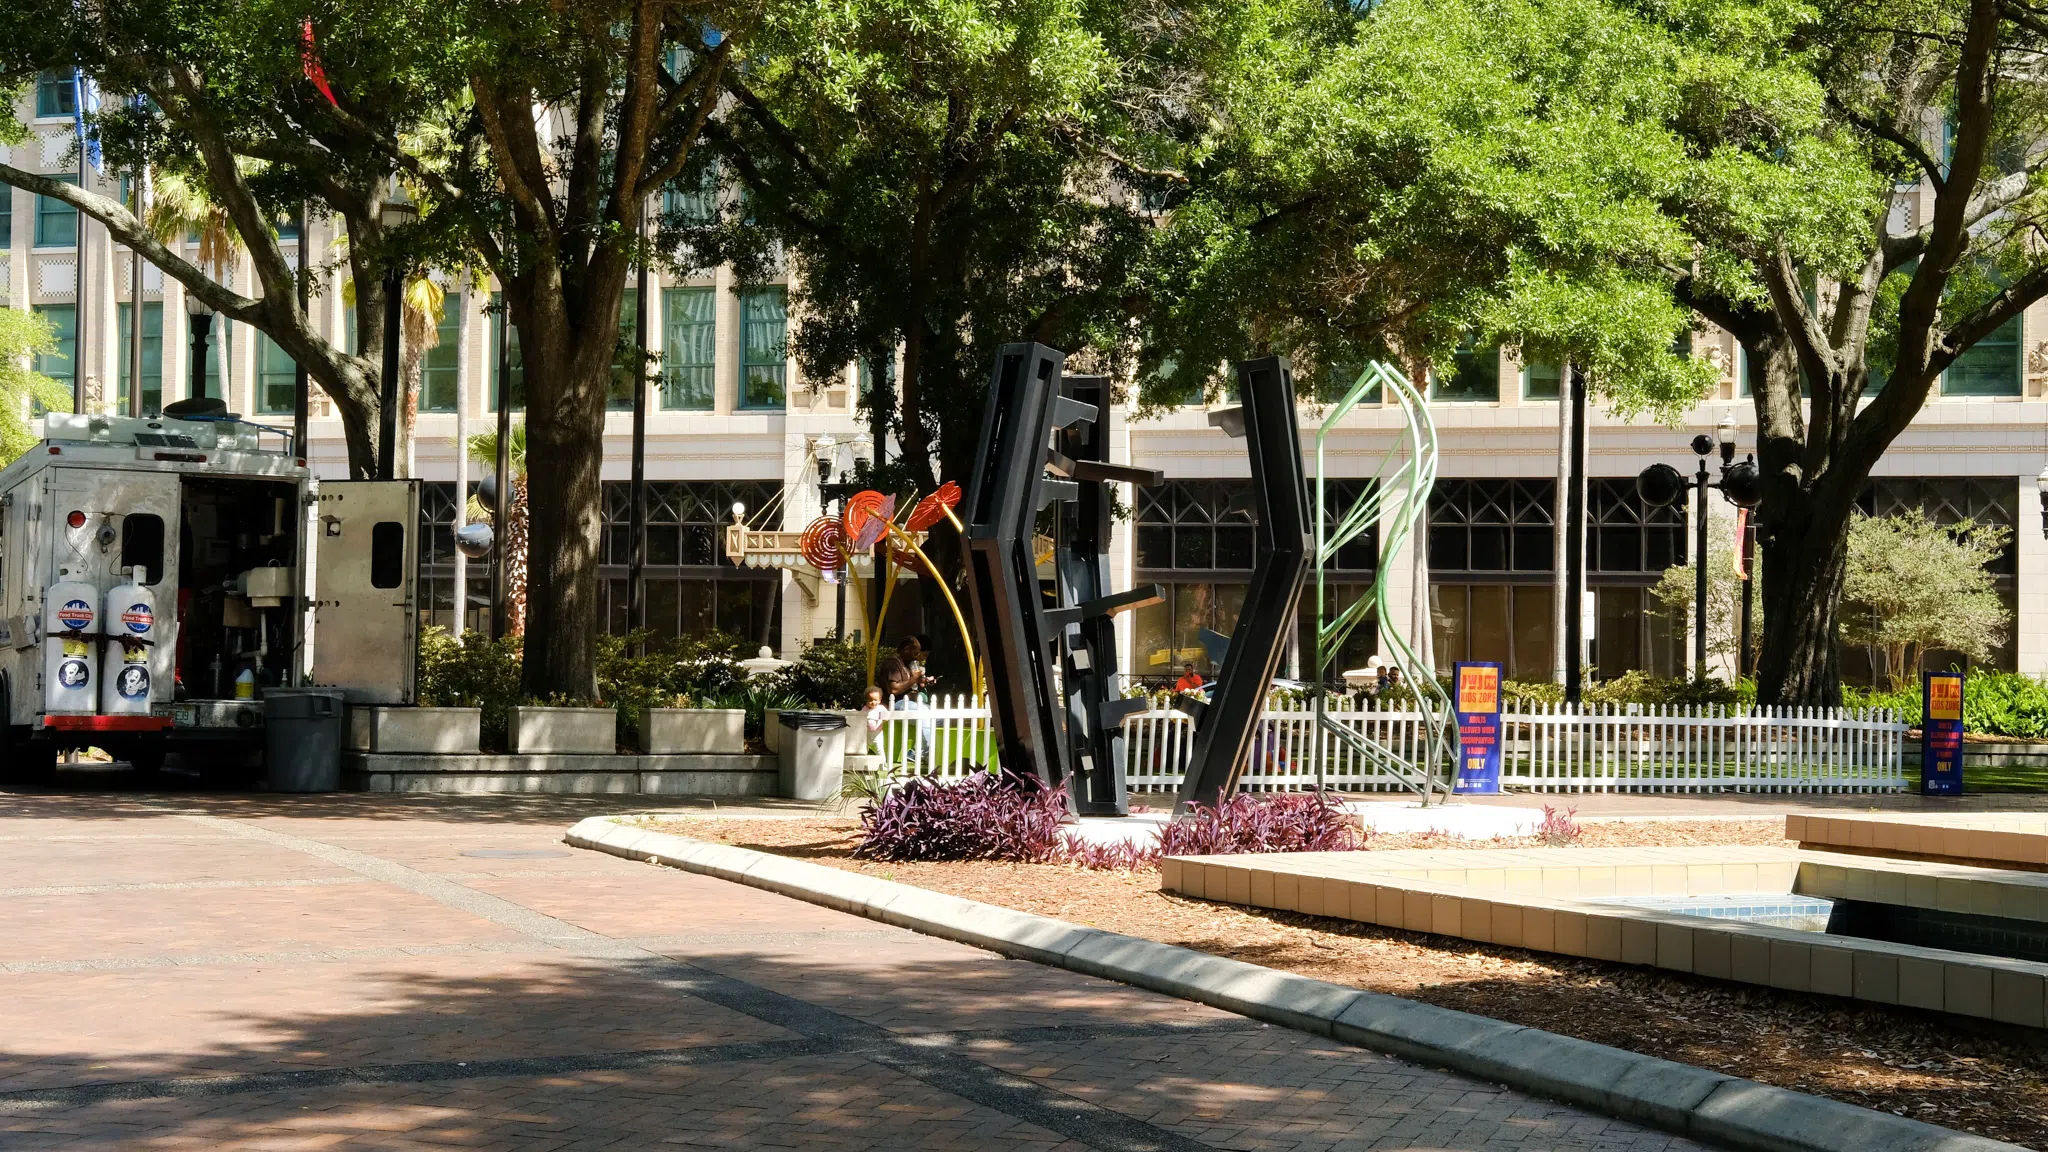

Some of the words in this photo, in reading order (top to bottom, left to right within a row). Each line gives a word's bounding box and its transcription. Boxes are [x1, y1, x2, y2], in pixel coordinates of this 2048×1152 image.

[1461, 692, 1477, 703] KIDS
[1479, 692, 1496, 704] ZONE
[1932, 700, 1944, 710] KIDS
[1946, 700, 1960, 711] ZONE
[1467, 758, 1485, 769] ONLY
[1937, 761, 1952, 772] ONLY
